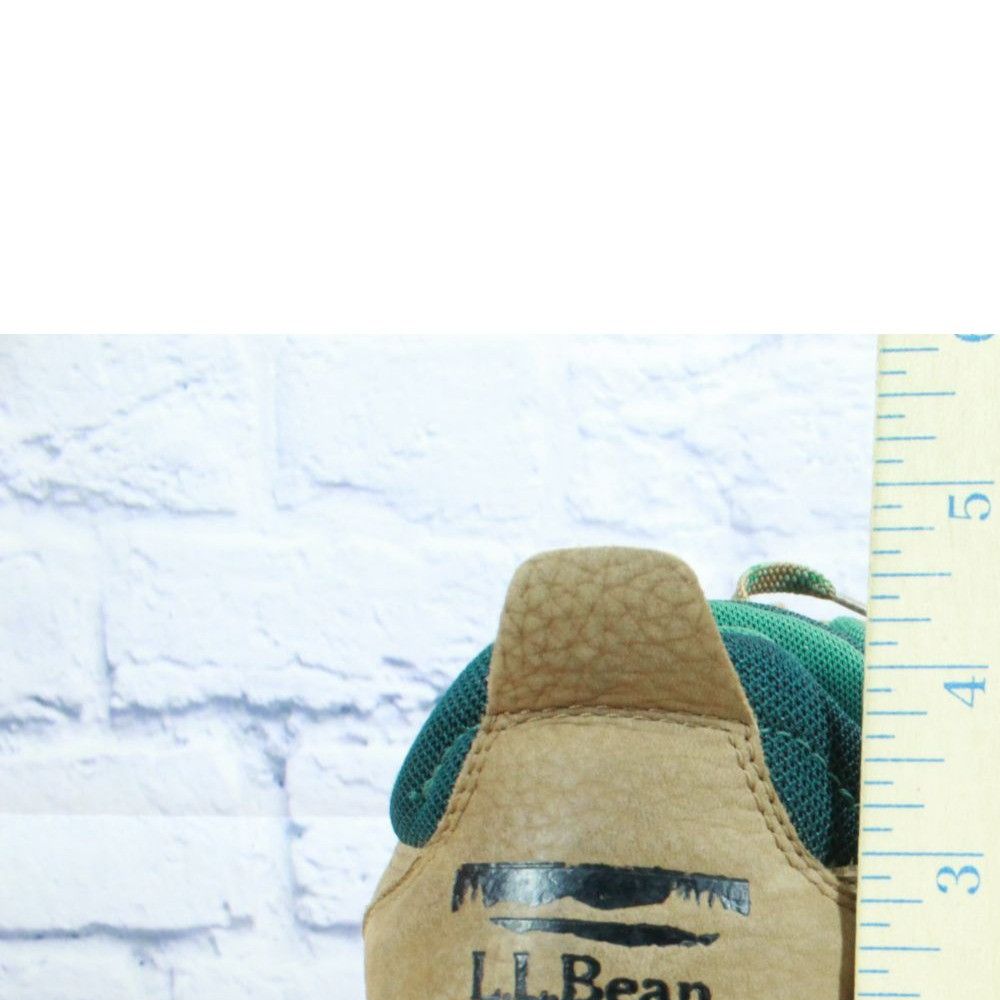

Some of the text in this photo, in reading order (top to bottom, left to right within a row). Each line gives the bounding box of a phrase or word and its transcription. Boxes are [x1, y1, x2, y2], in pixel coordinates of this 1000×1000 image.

[948, 492, 992, 521] 5
[943, 676, 986, 707] 4
[936, 865, 981, 895] 3
